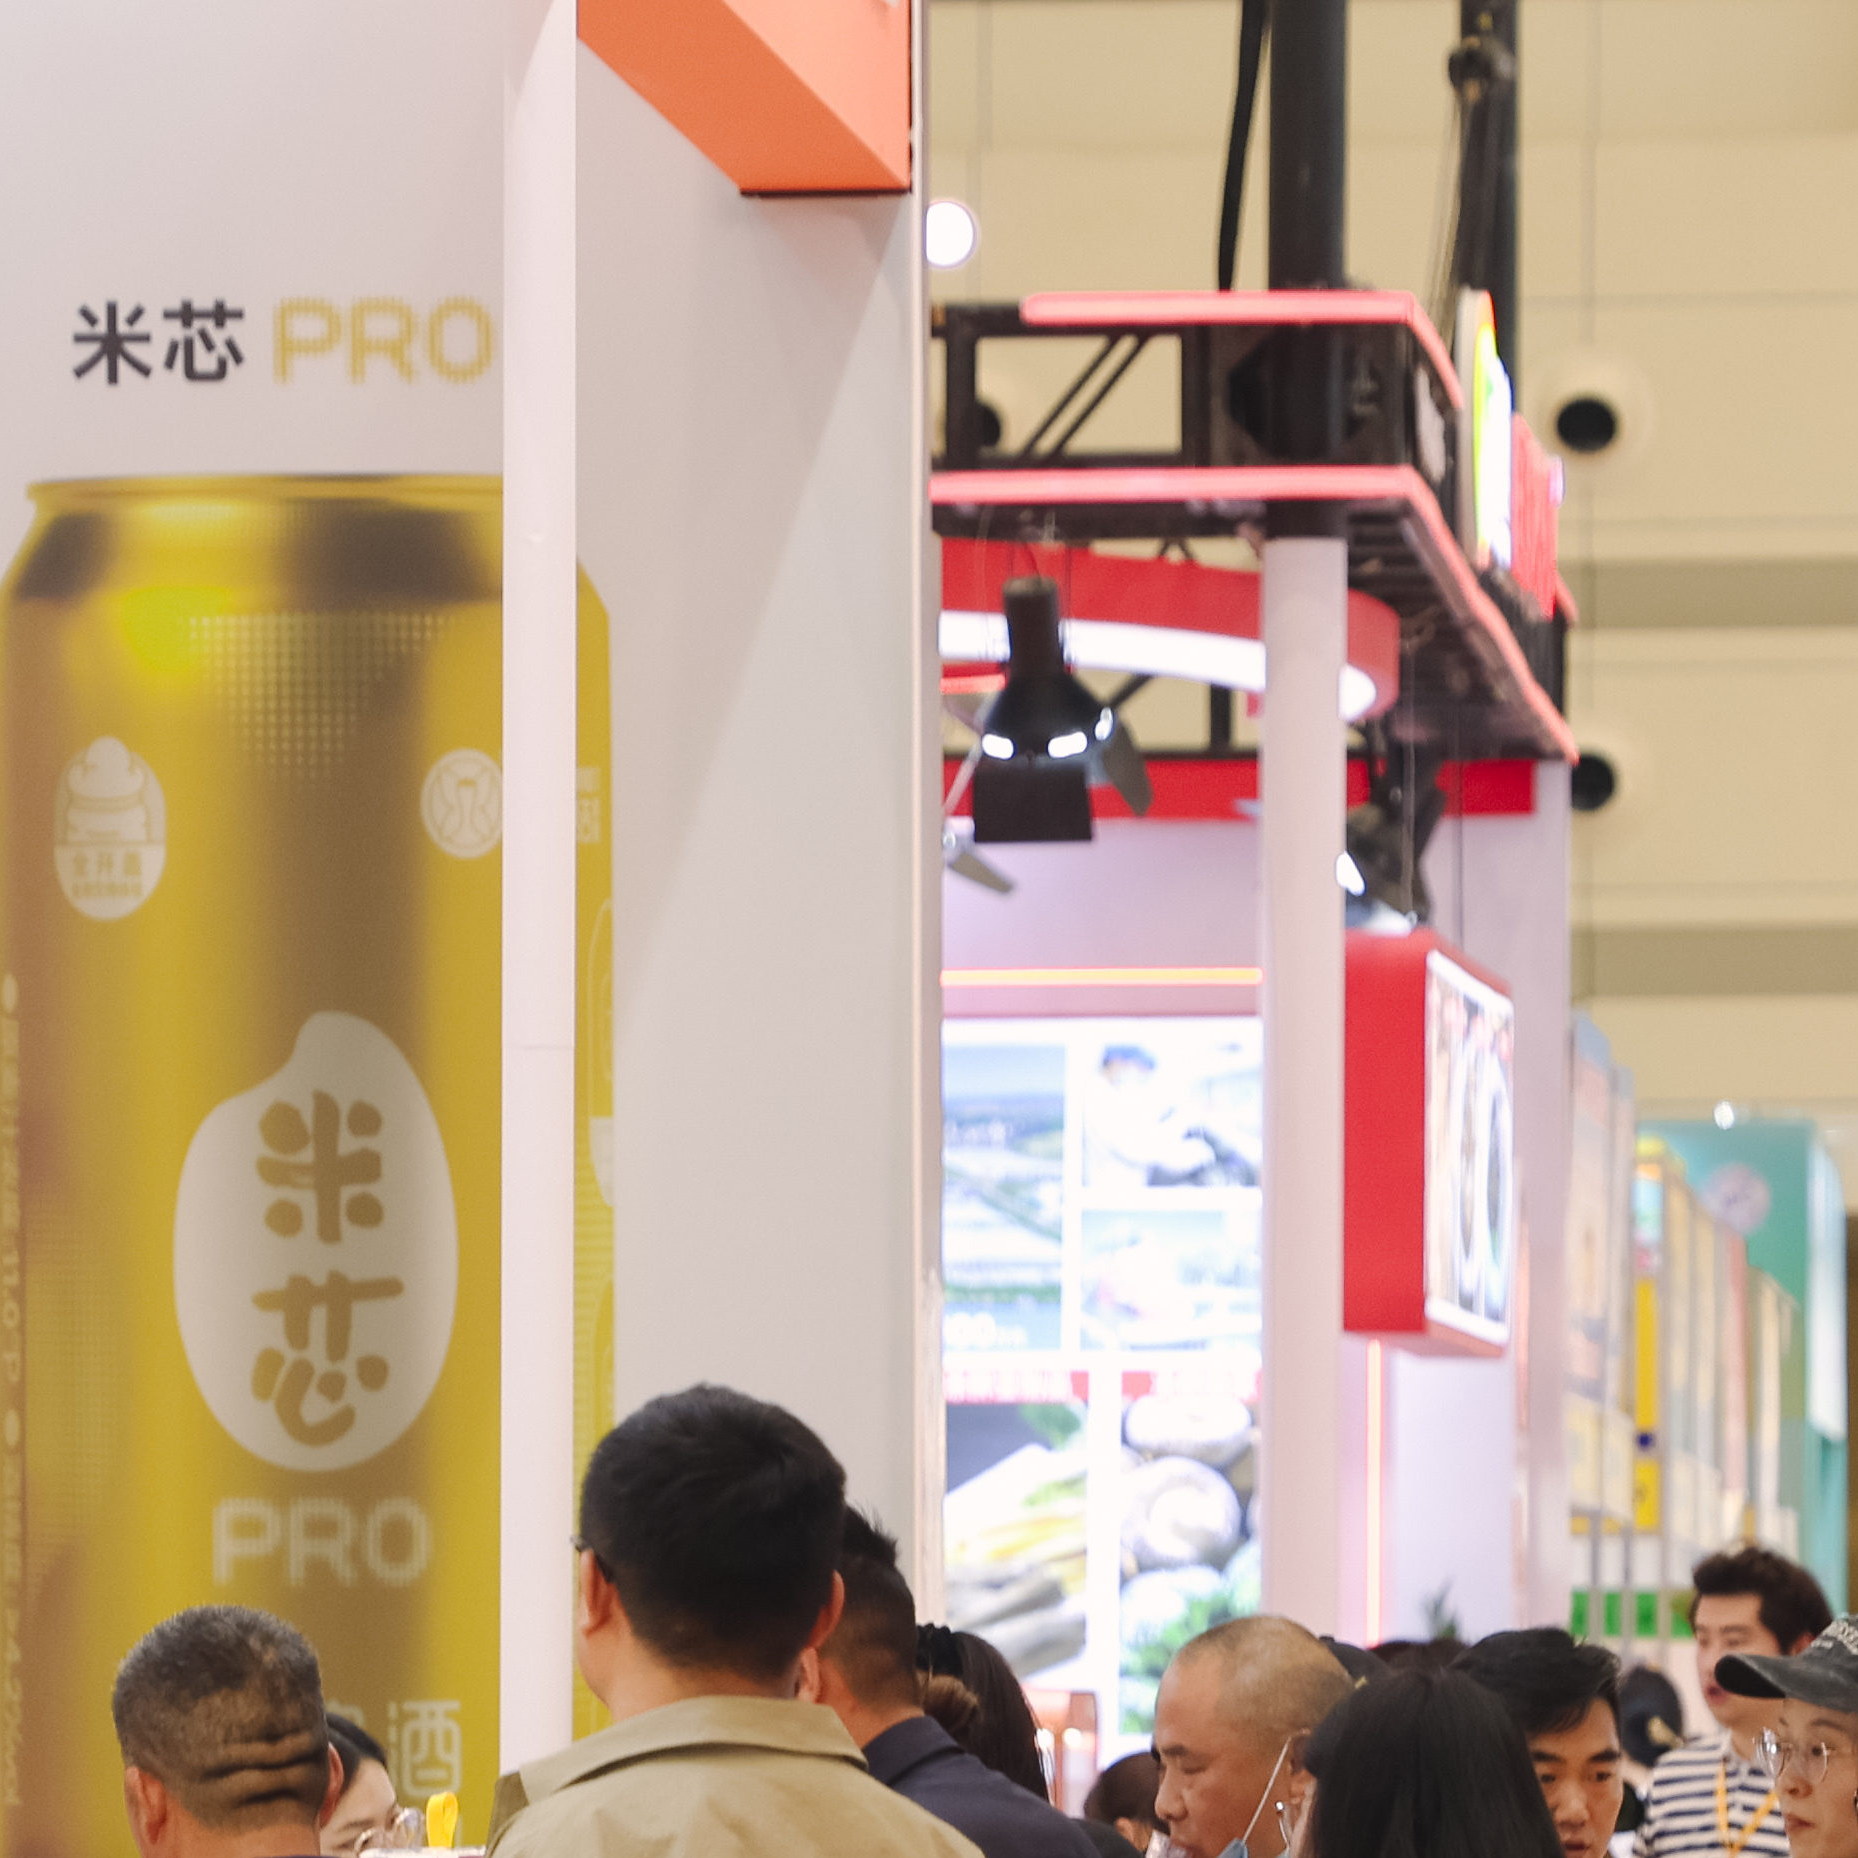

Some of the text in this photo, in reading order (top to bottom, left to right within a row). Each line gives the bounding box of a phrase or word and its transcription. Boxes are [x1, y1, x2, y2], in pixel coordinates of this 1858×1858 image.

[71, 295, 498, 387] 米芯 PRO
[251, 1088, 406, 1448] 米芯
[212, 1496, 434, 1591] PRO
